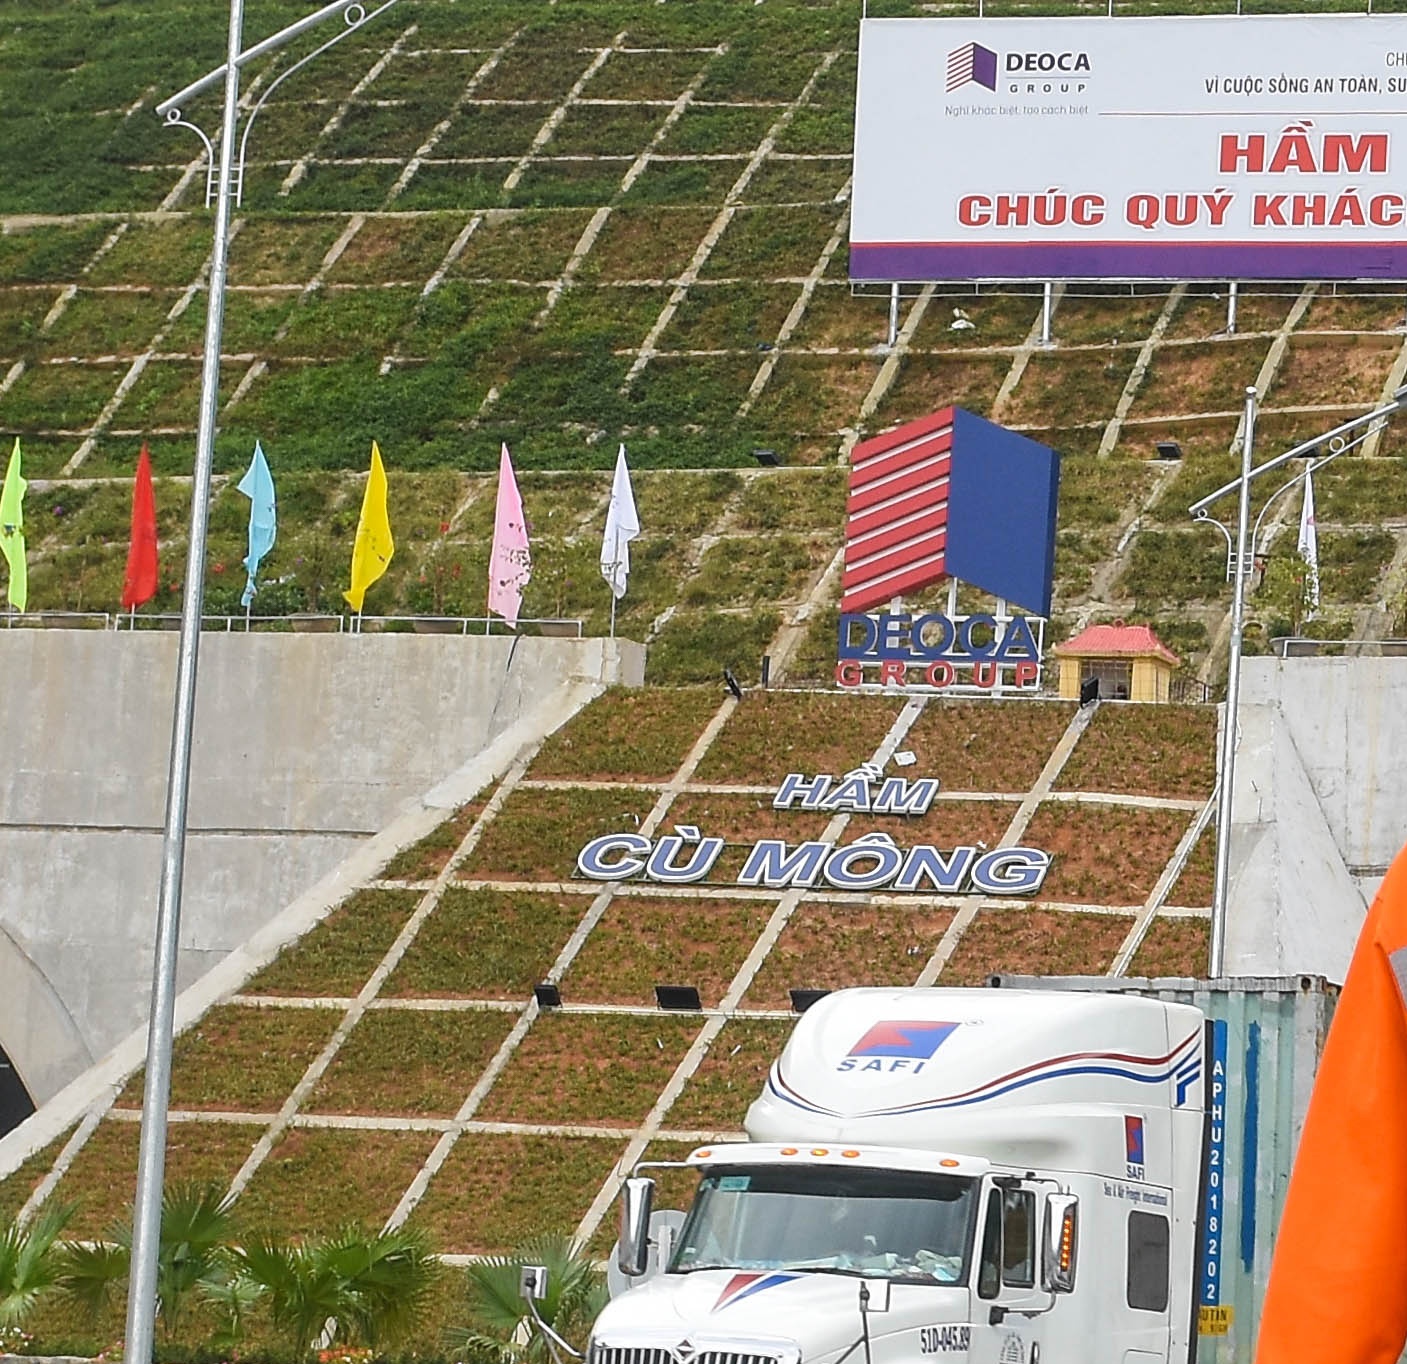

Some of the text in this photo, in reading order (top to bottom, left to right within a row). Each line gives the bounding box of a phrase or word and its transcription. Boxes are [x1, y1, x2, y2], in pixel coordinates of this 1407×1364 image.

[1006, 53, 1091, 72] DEOCA
[1009, 83, 1086, 94] GROUP
[1205, 75, 1218, 94] VÌ
[1223, 76, 1263, 96] CUỘC
[1268, 72, 1309, 94] SỐNG
[1314, 78, 1333, 93] AN
[1339, 74, 1382, 94] TOÀN,
[1219, 120, 1389, 175] HẦM
[957, 188, 1106, 227] CHÚC
[1125, 188, 1236, 231] QUÝ
[838, 613, 1041, 661] DEOCA
[834, 660, 1040, 688] GROUP
[773, 763, 940, 815] HẦM
[577, 825, 1053, 894] CÙ MÔNG
[836, 1059, 926, 1074] SAFI
[1126, 1164, 1145, 1181] SAFI
